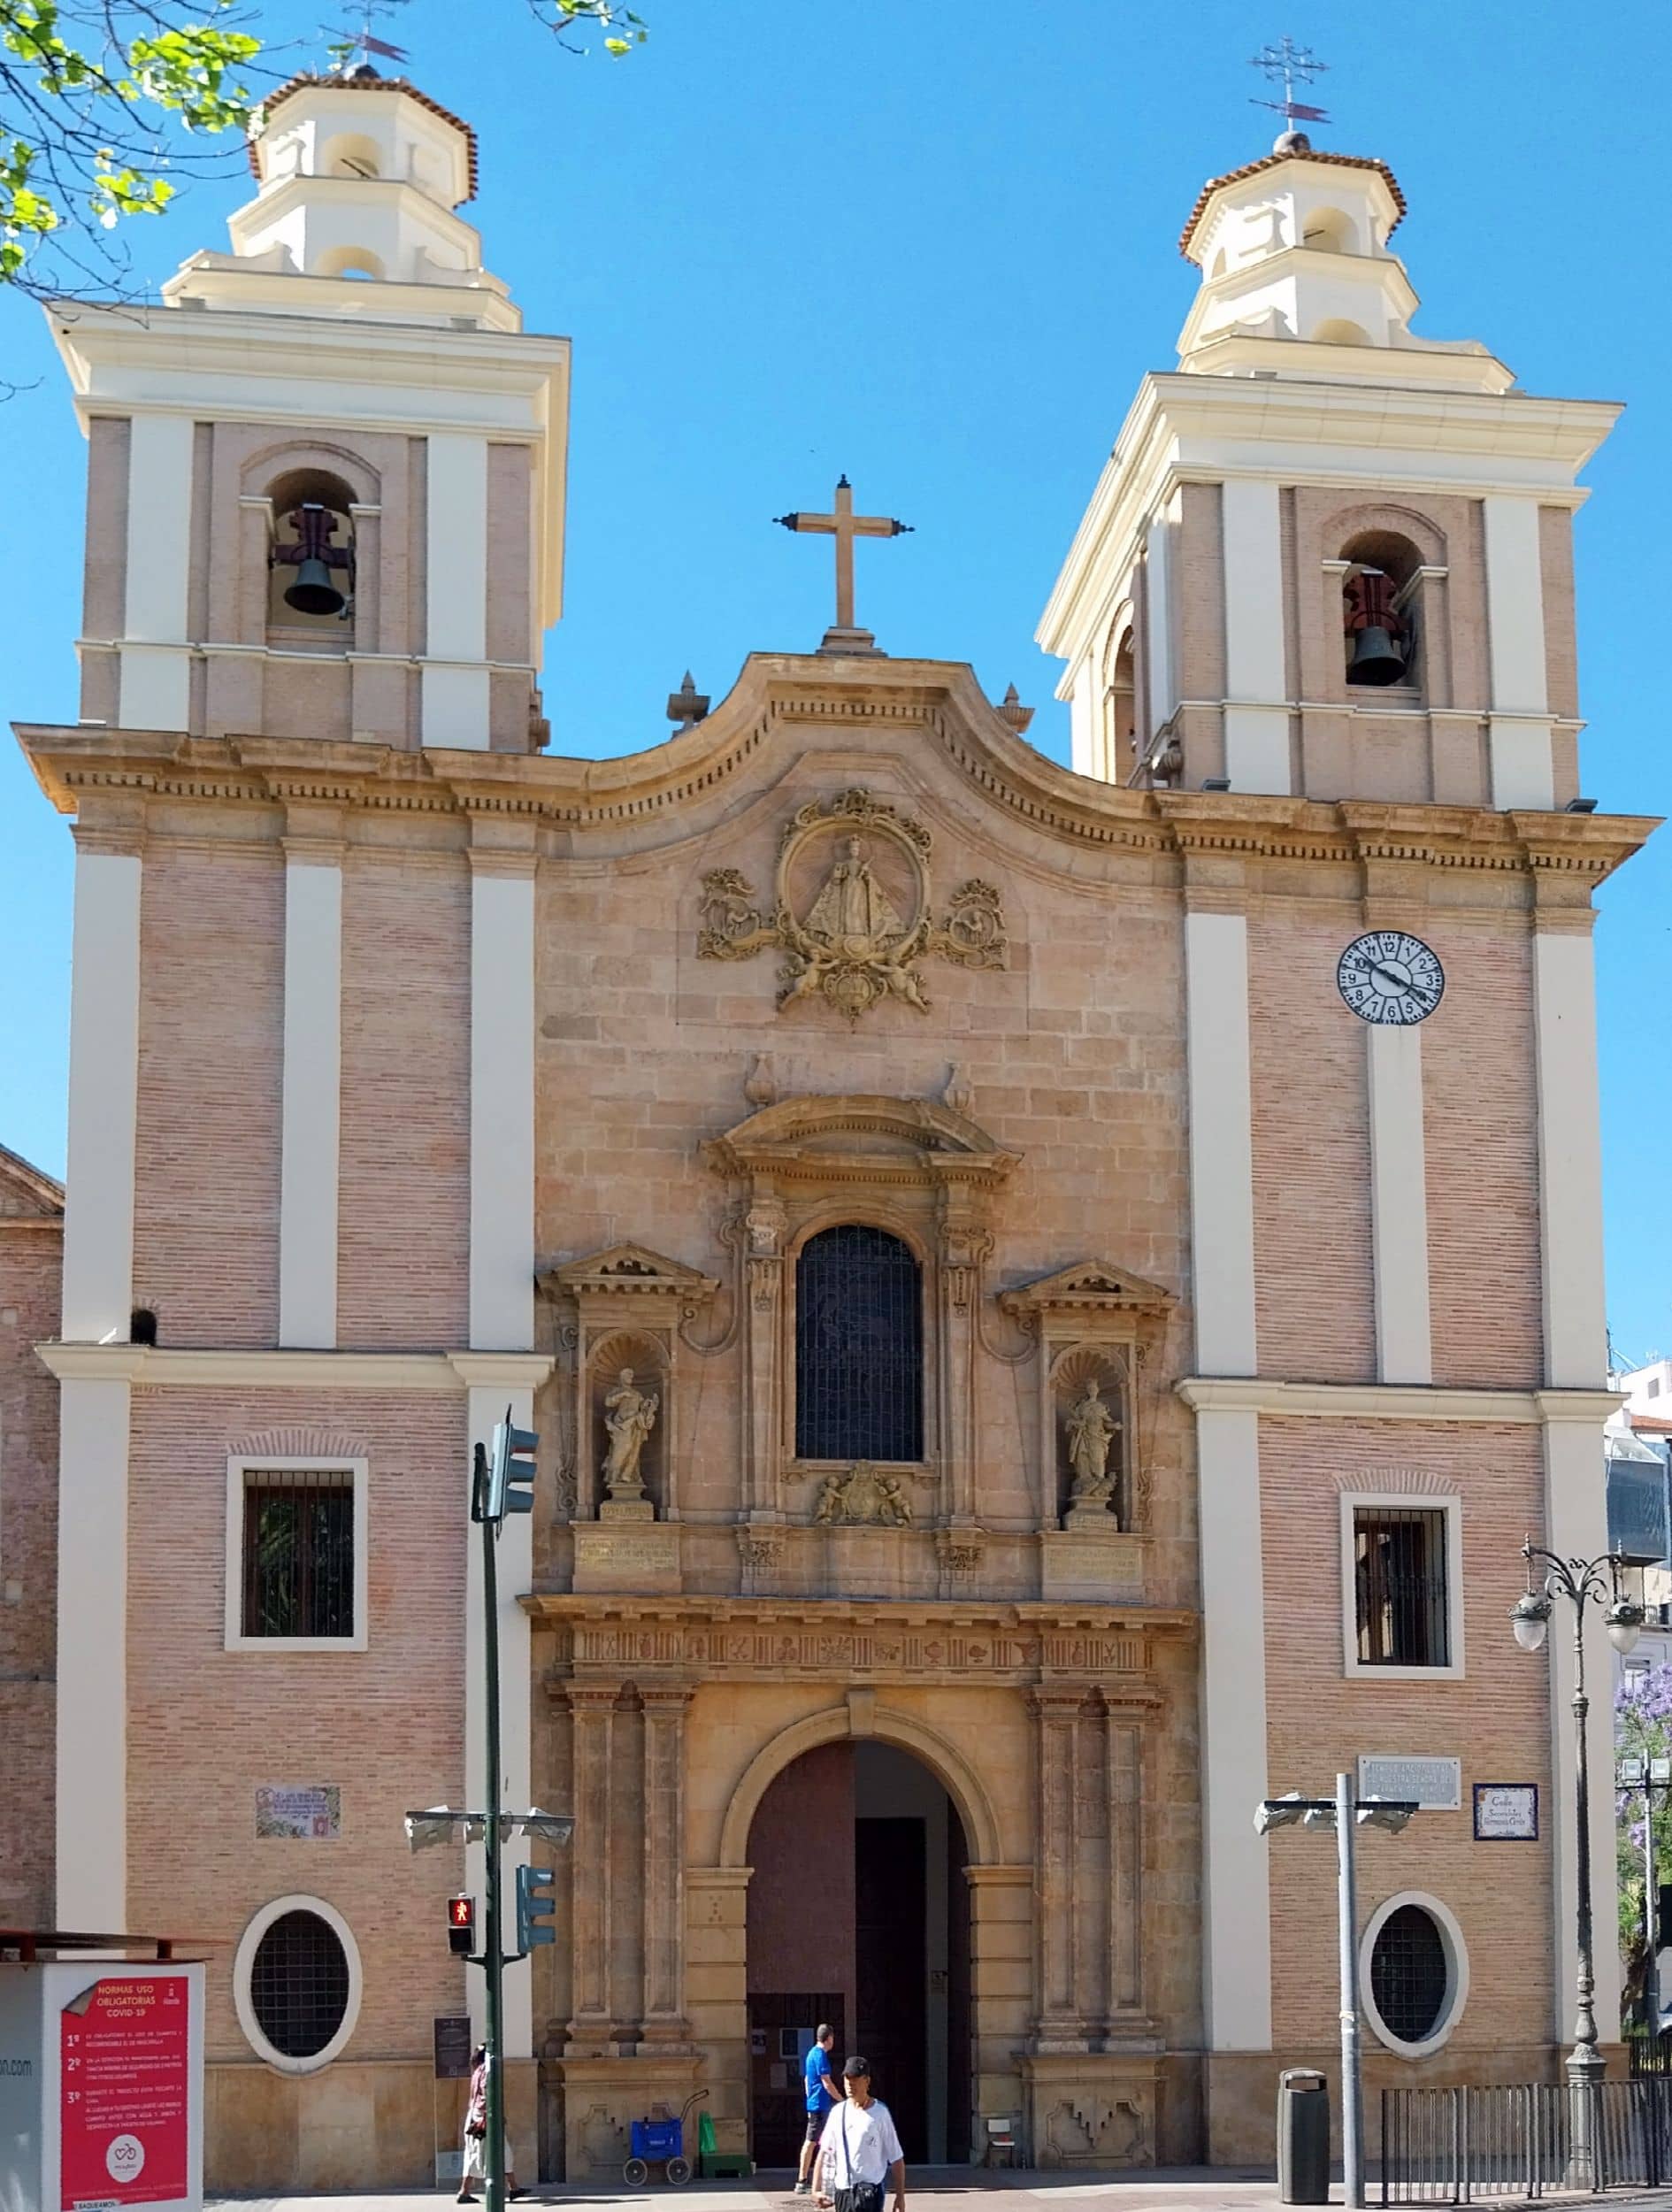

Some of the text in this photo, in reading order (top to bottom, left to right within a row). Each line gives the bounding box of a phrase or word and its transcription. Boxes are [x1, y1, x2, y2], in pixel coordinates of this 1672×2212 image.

[1366, 946, 1377, 956] 11
[1384, 941, 1395, 953] 12
[1405, 947, 1411, 957] 1
[1354, 956, 1366, 969] 10
[1419, 958, 1427, 970] 2
[1348, 973, 1356, 984] 9
[1426, 974, 1434, 987] 3
[1355, 990, 1364, 1001] 8
[1371, 1002, 1379, 1014] 7
[1387, 1006, 1396, 1018] 6
[1406, 1002, 1414, 1014] 5
[1492, 1795, 1513, 1807] Calle
[98, 1985, 154, 1994] NORMAS USO
[96, 1996, 156, 2007] OBLIGATORIAS
[106, 2008, 146, 2017] COVID-19
